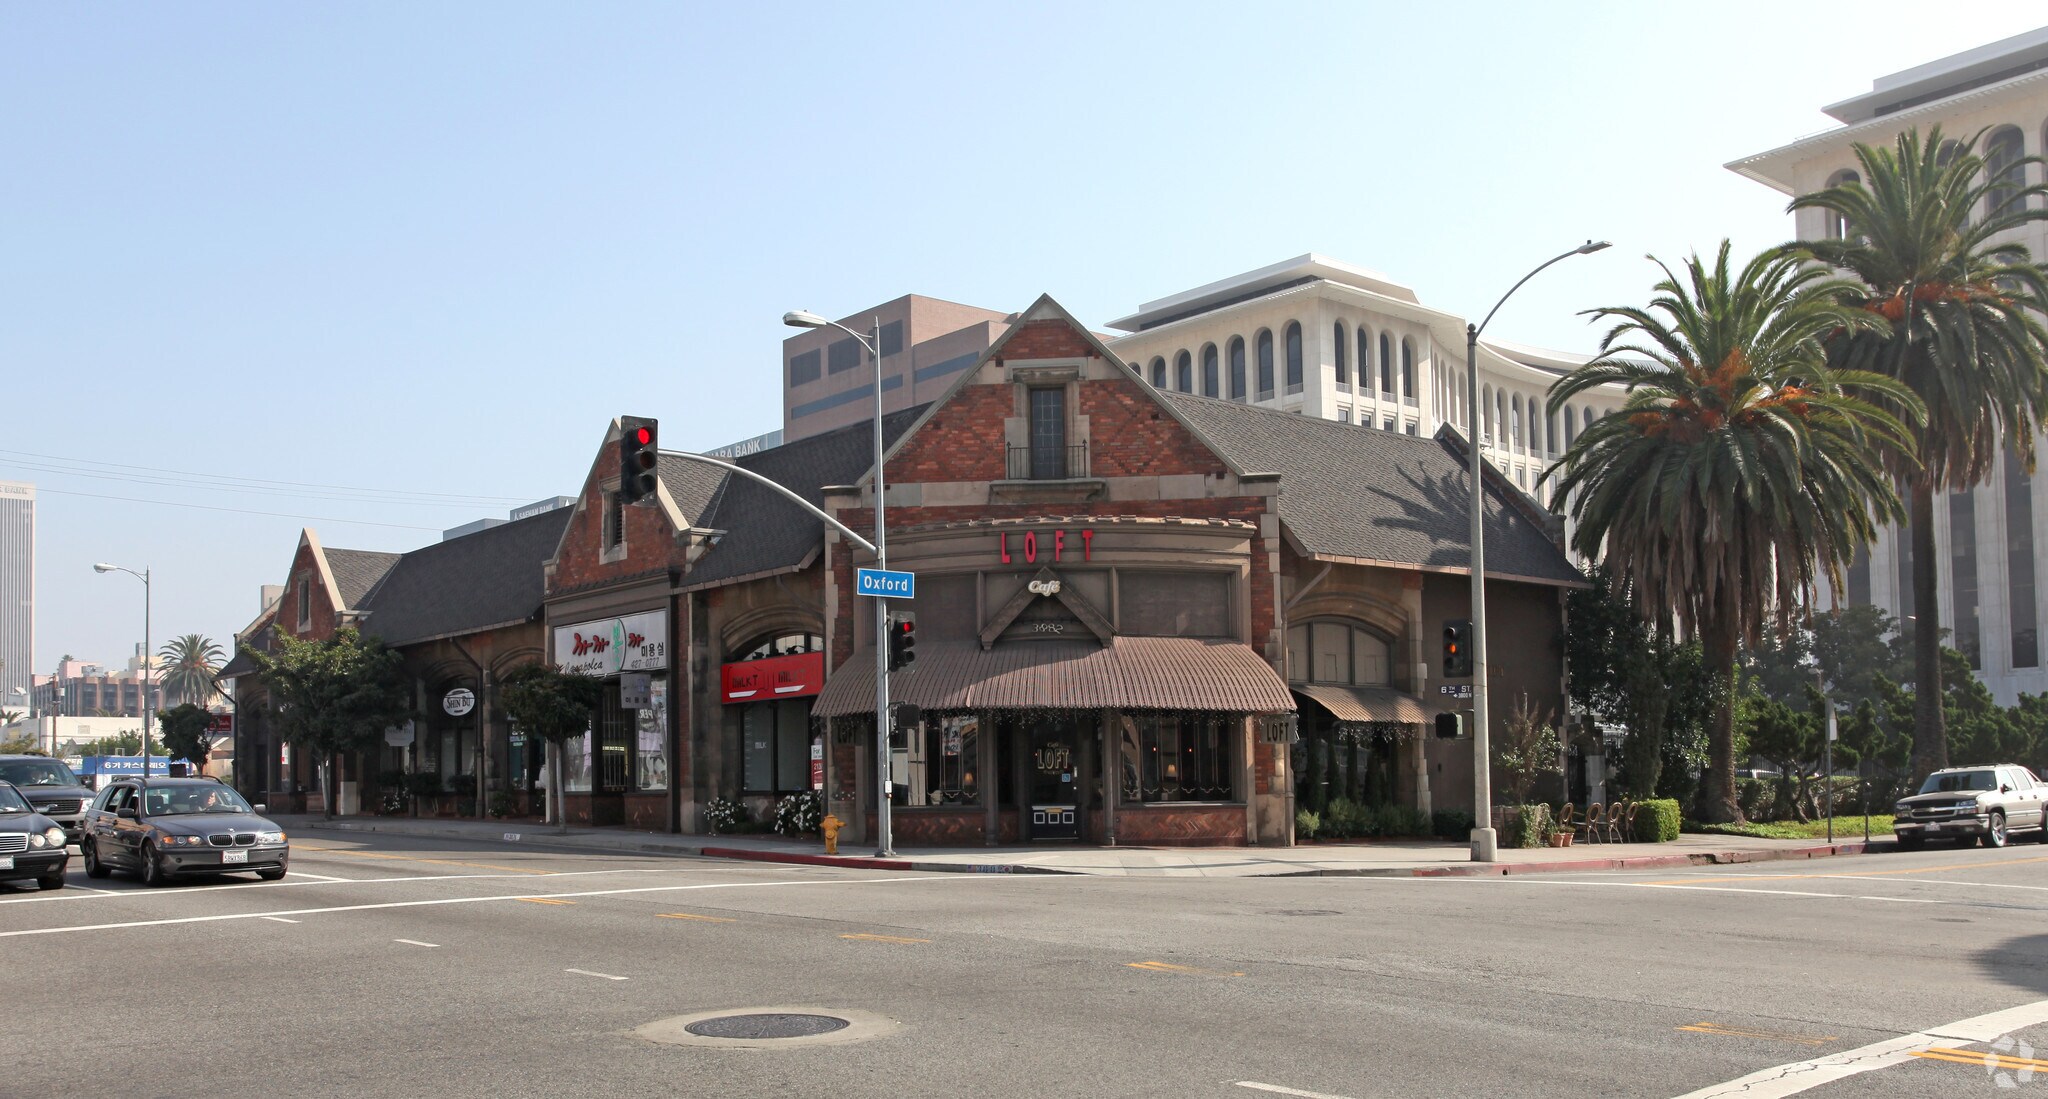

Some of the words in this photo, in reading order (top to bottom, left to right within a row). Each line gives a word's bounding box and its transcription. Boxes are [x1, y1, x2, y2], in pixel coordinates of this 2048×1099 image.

[735, 439, 760, 457] BANK
[1001, 529, 1094, 564] LOFT
[864, 575, 908, 592] Oxford
[1028, 580, 1061, 597] Café
[1266, 722, 1290, 741] LOFT
[1037, 748, 1070, 769] LOFT
